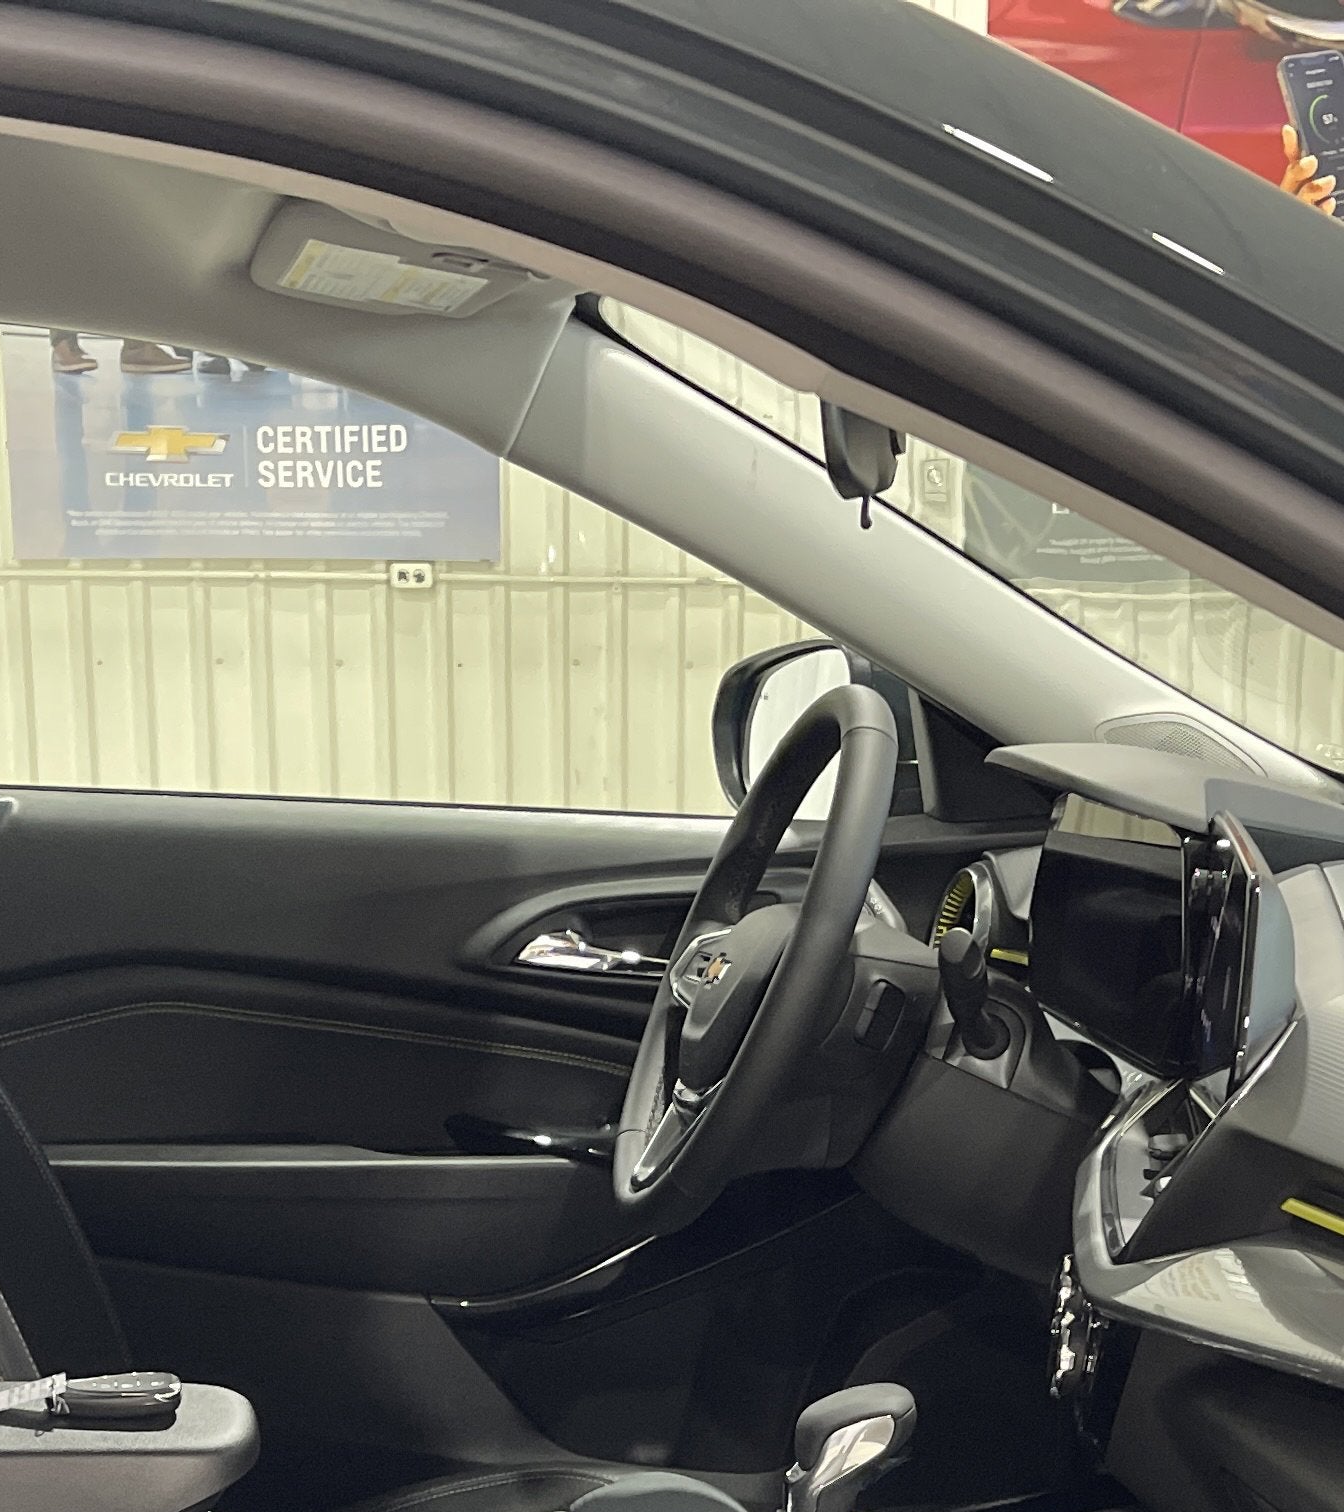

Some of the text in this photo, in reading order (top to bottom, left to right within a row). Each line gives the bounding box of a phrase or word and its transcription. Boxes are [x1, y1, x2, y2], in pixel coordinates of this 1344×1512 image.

[256, 424, 408, 453] CERTIFIED
[104, 471, 235, 488] CHEVROLET
[257, 460, 383, 488] SERVICE
